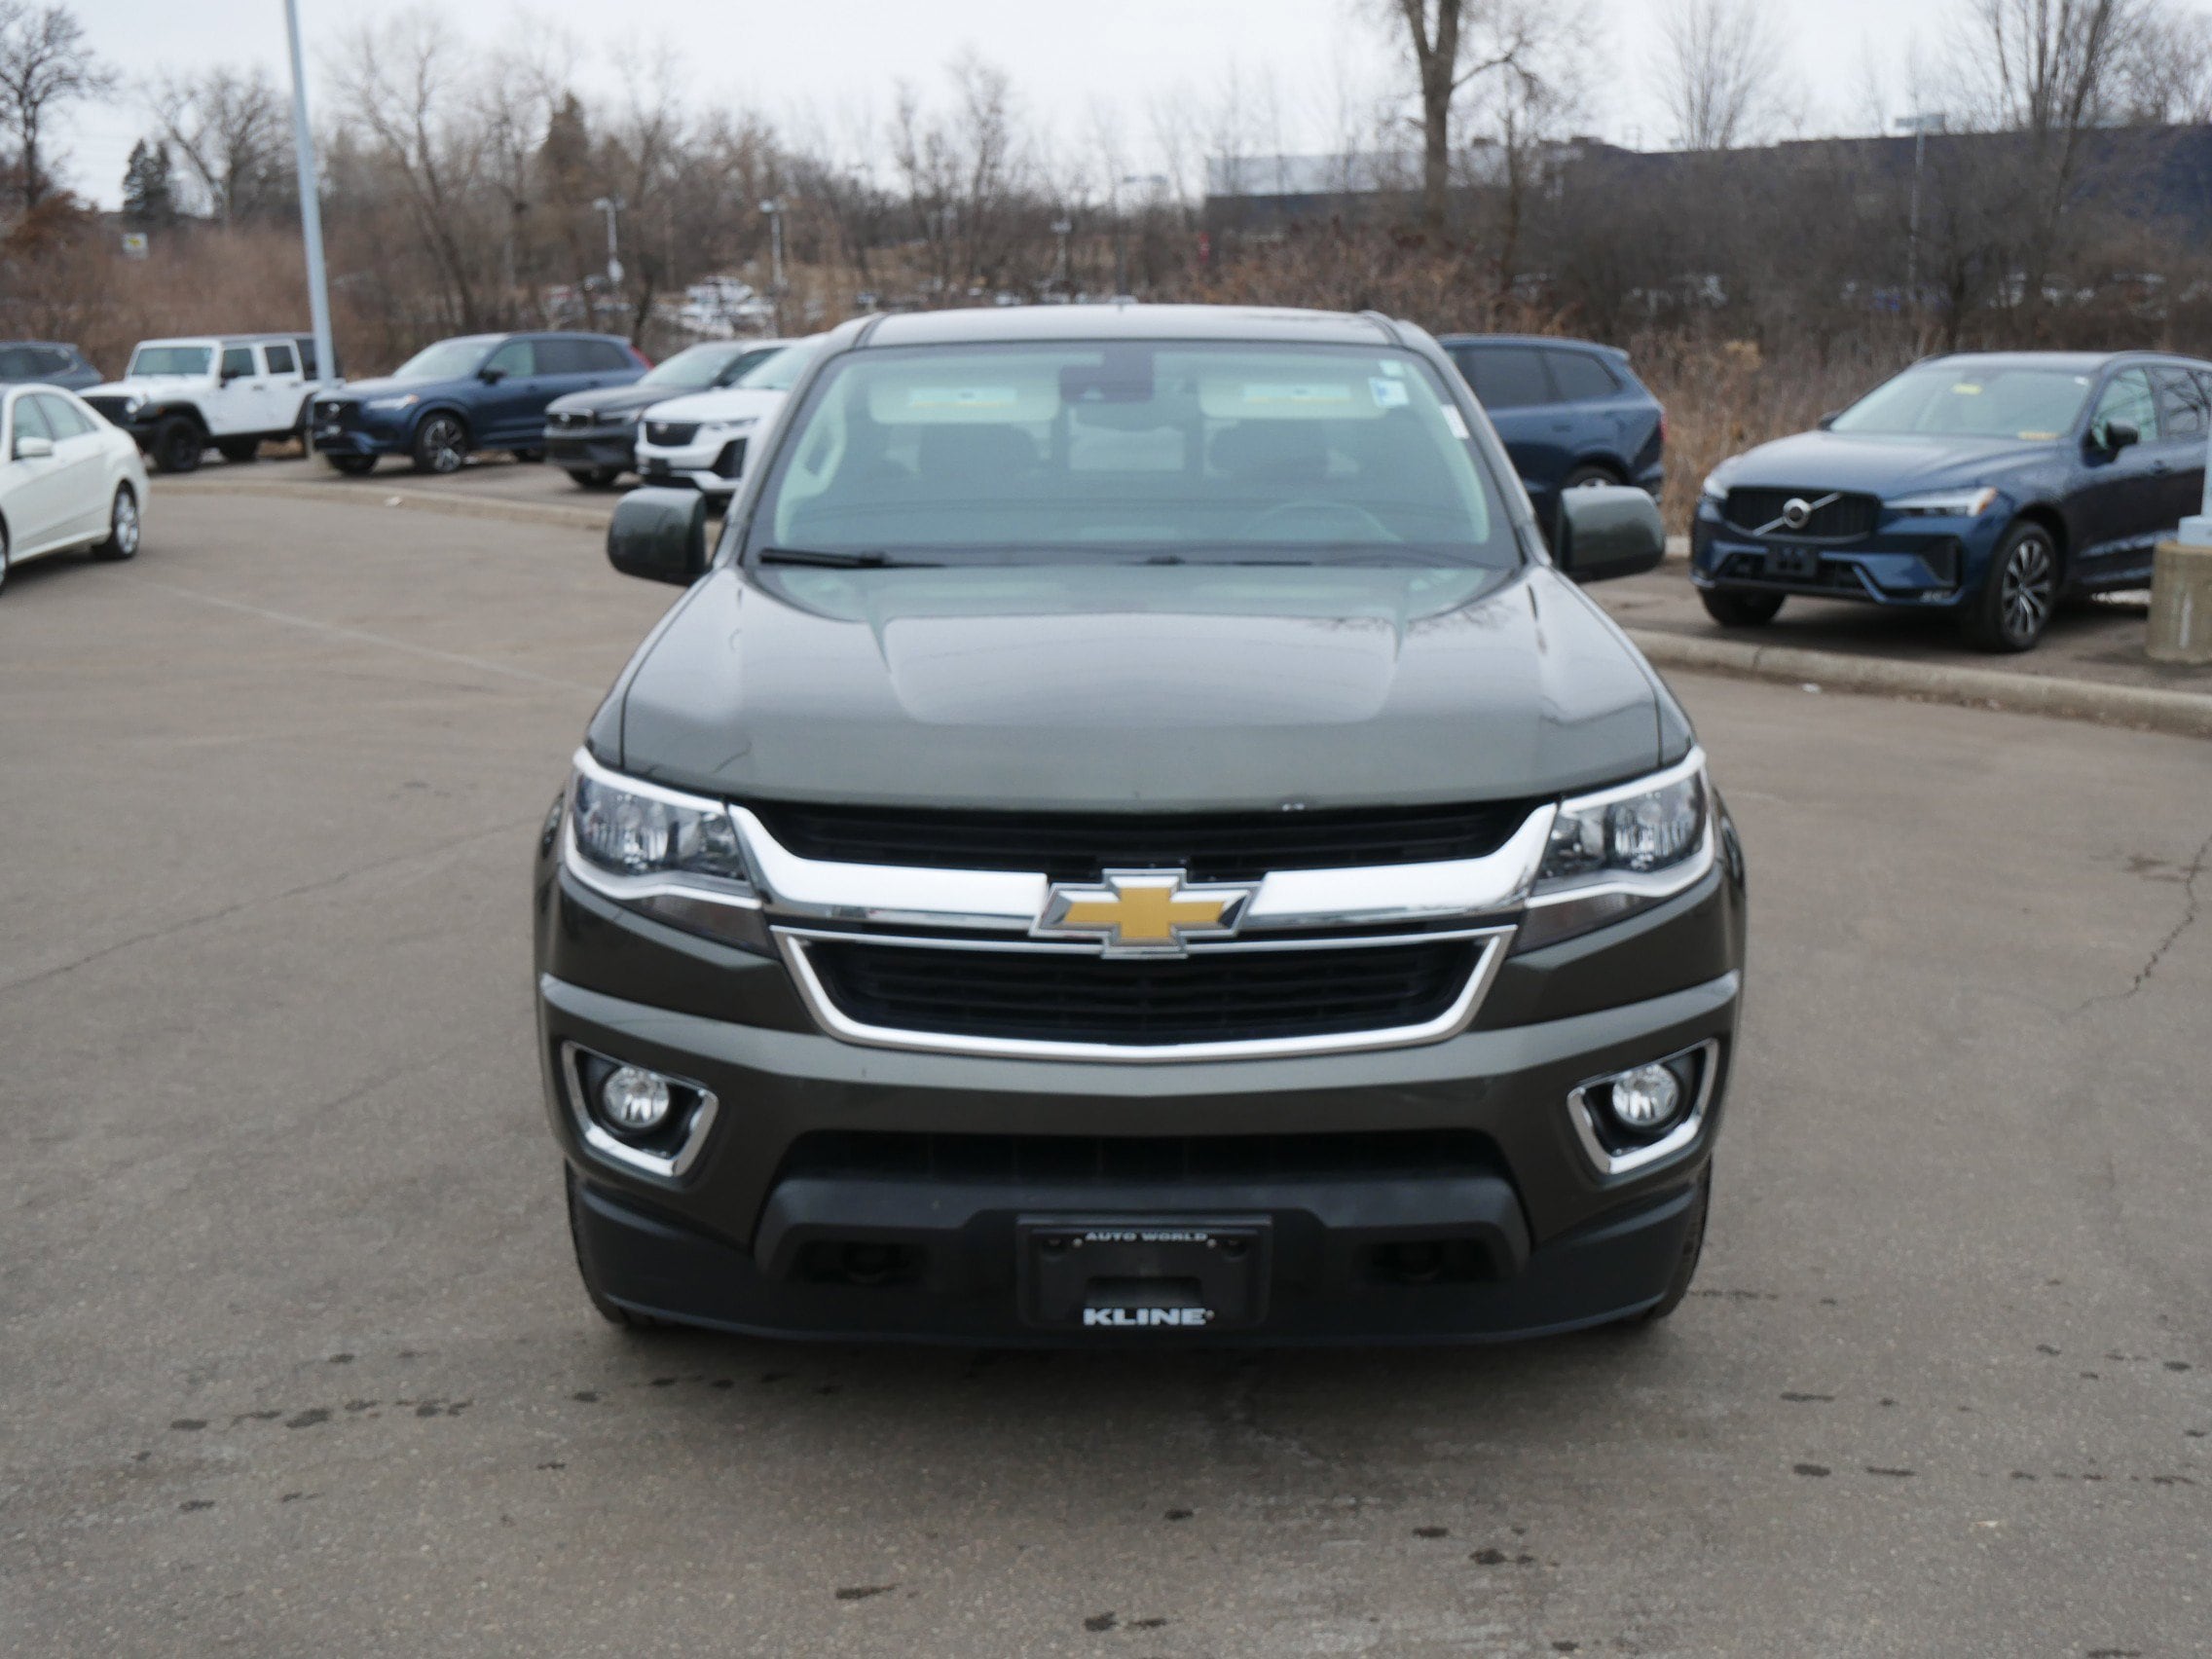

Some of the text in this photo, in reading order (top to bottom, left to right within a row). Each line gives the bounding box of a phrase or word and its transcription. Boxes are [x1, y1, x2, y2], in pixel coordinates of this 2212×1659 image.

[1085, 1232, 1207, 1241] AUTO WORLD
[1083, 1308, 1206, 1326] KLINE
